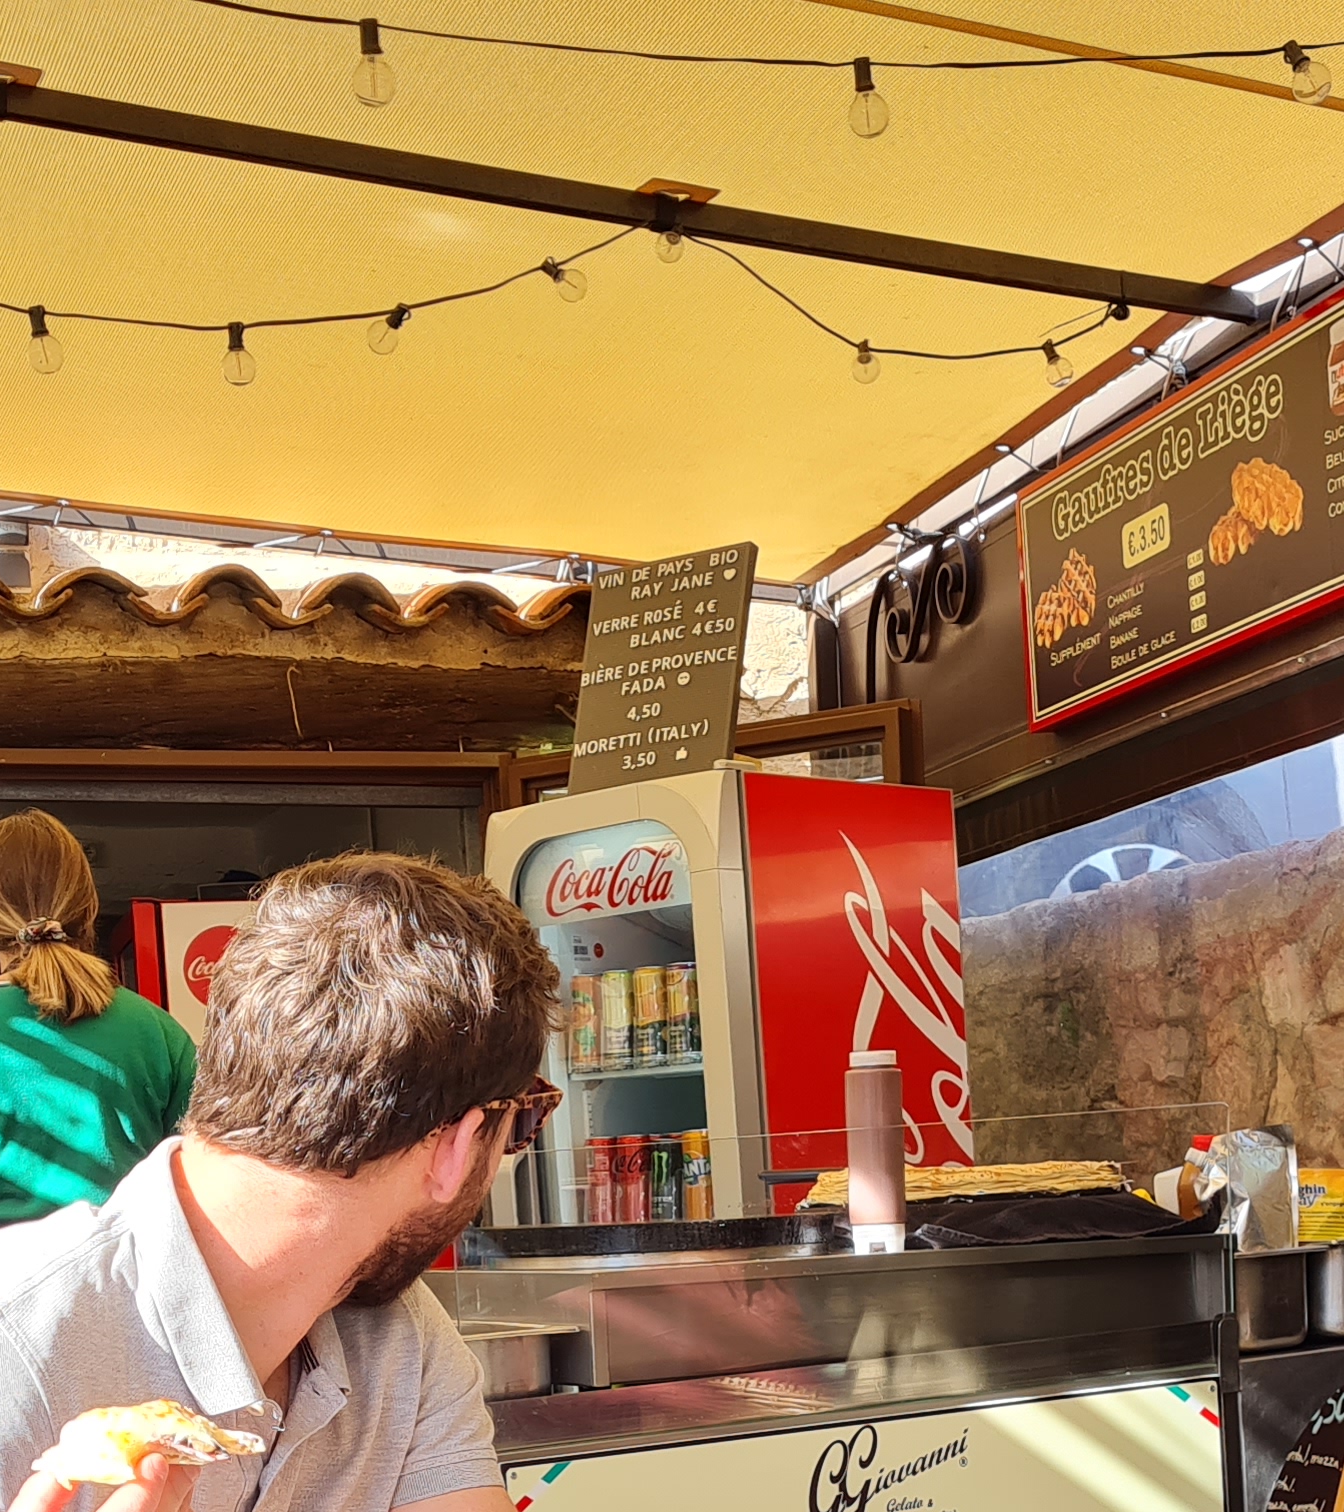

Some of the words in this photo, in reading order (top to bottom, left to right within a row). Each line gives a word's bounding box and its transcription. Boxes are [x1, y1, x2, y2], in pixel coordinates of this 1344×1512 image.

[1052, 449, 1155, 541] Gaufres
[1157, 425, 1194, 481] de
[1196, 373, 1284, 460] Liège
[1127, 514, 1167, 558] €.3.50
[598, 571, 625, 590] VIN
[631, 566, 652, 583] DE
[657, 557, 695, 578] PAYS
[709, 549, 739, 568] BIO
[630, 581, 663, 600] RAY
[670, 571, 715, 592] JANE
[1107, 581, 1145, 609] CHANTILLY
[592, 613, 640, 637] VERRE
[643, 600, 684, 626] ROSÉ
[694, 599, 718, 616] 4€
[629, 625, 686, 649] BLANC
[691, 617, 735, 637] 4€50
[1108, 604, 1144, 630] NAPPAGE
[1109, 626, 1140, 650] BANANE
[1110, 648, 1138, 670] BOULE
[1138, 642, 1150, 658] DE
[1150, 630, 1177, 651] GLACE
[580, 663, 624, 688] BIÈRE
[628, 661, 649, 678] DE
[651, 645, 738, 673] PROVENCE
[621, 675, 666, 696] FADA
[626, 702, 662, 722] 4,50
[573, 731, 642, 758] MORETTI
[647, 718, 710, 744] (ITALY)
[621, 751, 657, 770] 3,50
